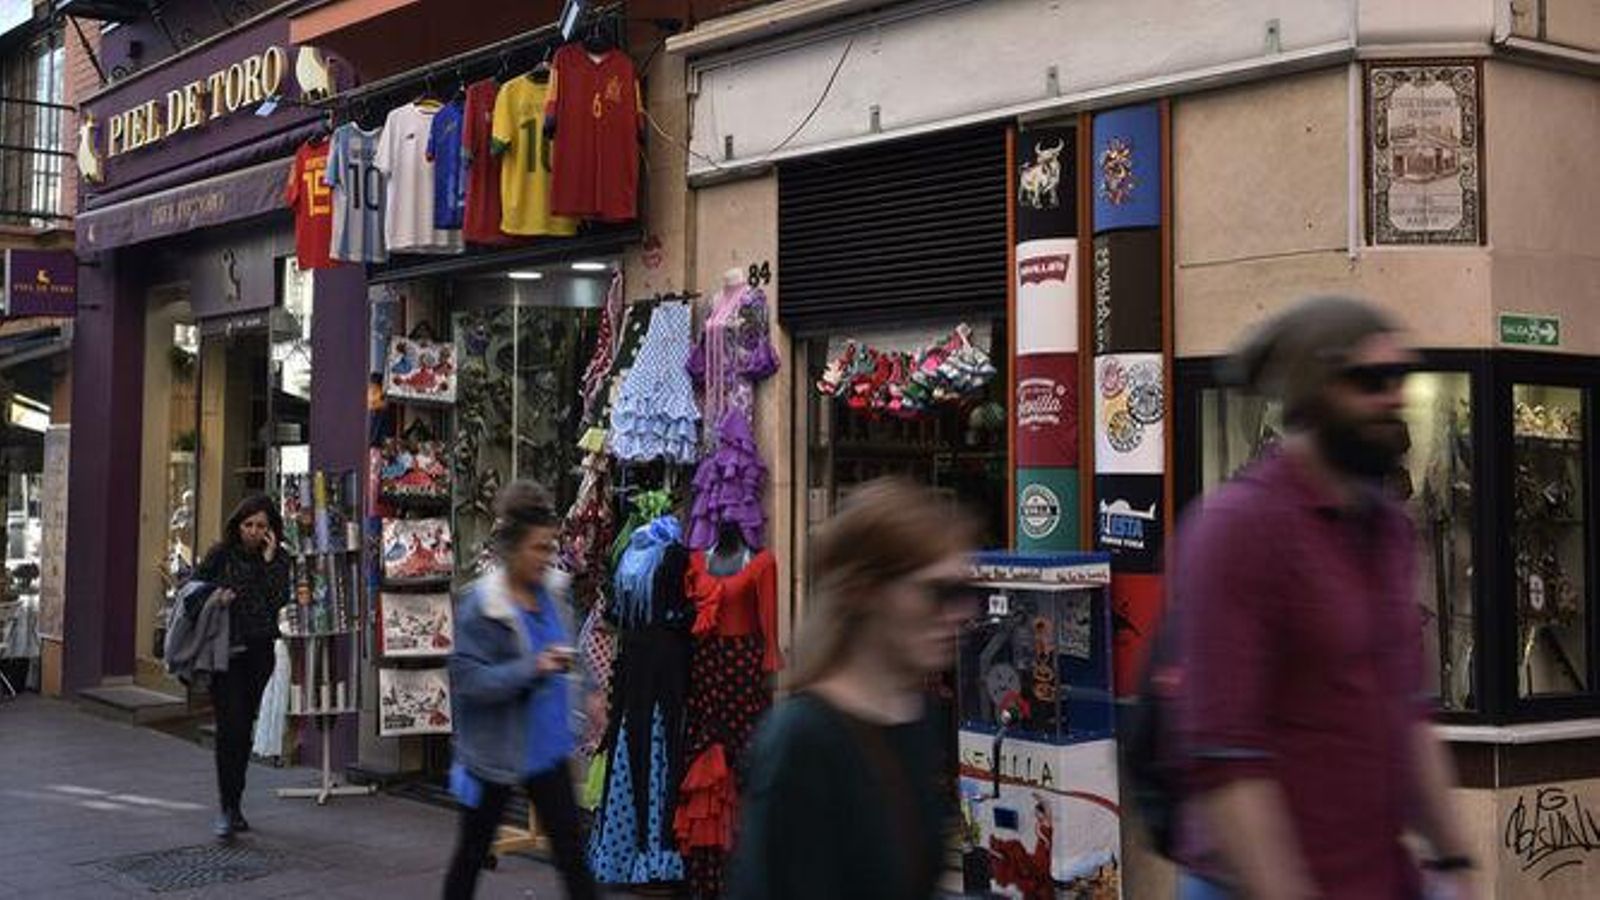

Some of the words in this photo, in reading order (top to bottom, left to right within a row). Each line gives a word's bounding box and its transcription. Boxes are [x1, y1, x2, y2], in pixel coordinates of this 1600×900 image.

[107, 99, 161, 158] PIEL
[166, 82, 203, 136] DE
[208, 46, 284, 120] TORO
[593, 92, 601, 118] 6
[303, 169, 331, 216] 15
[348, 164, 383, 209] 10
[748, 260, 771, 288] 84
